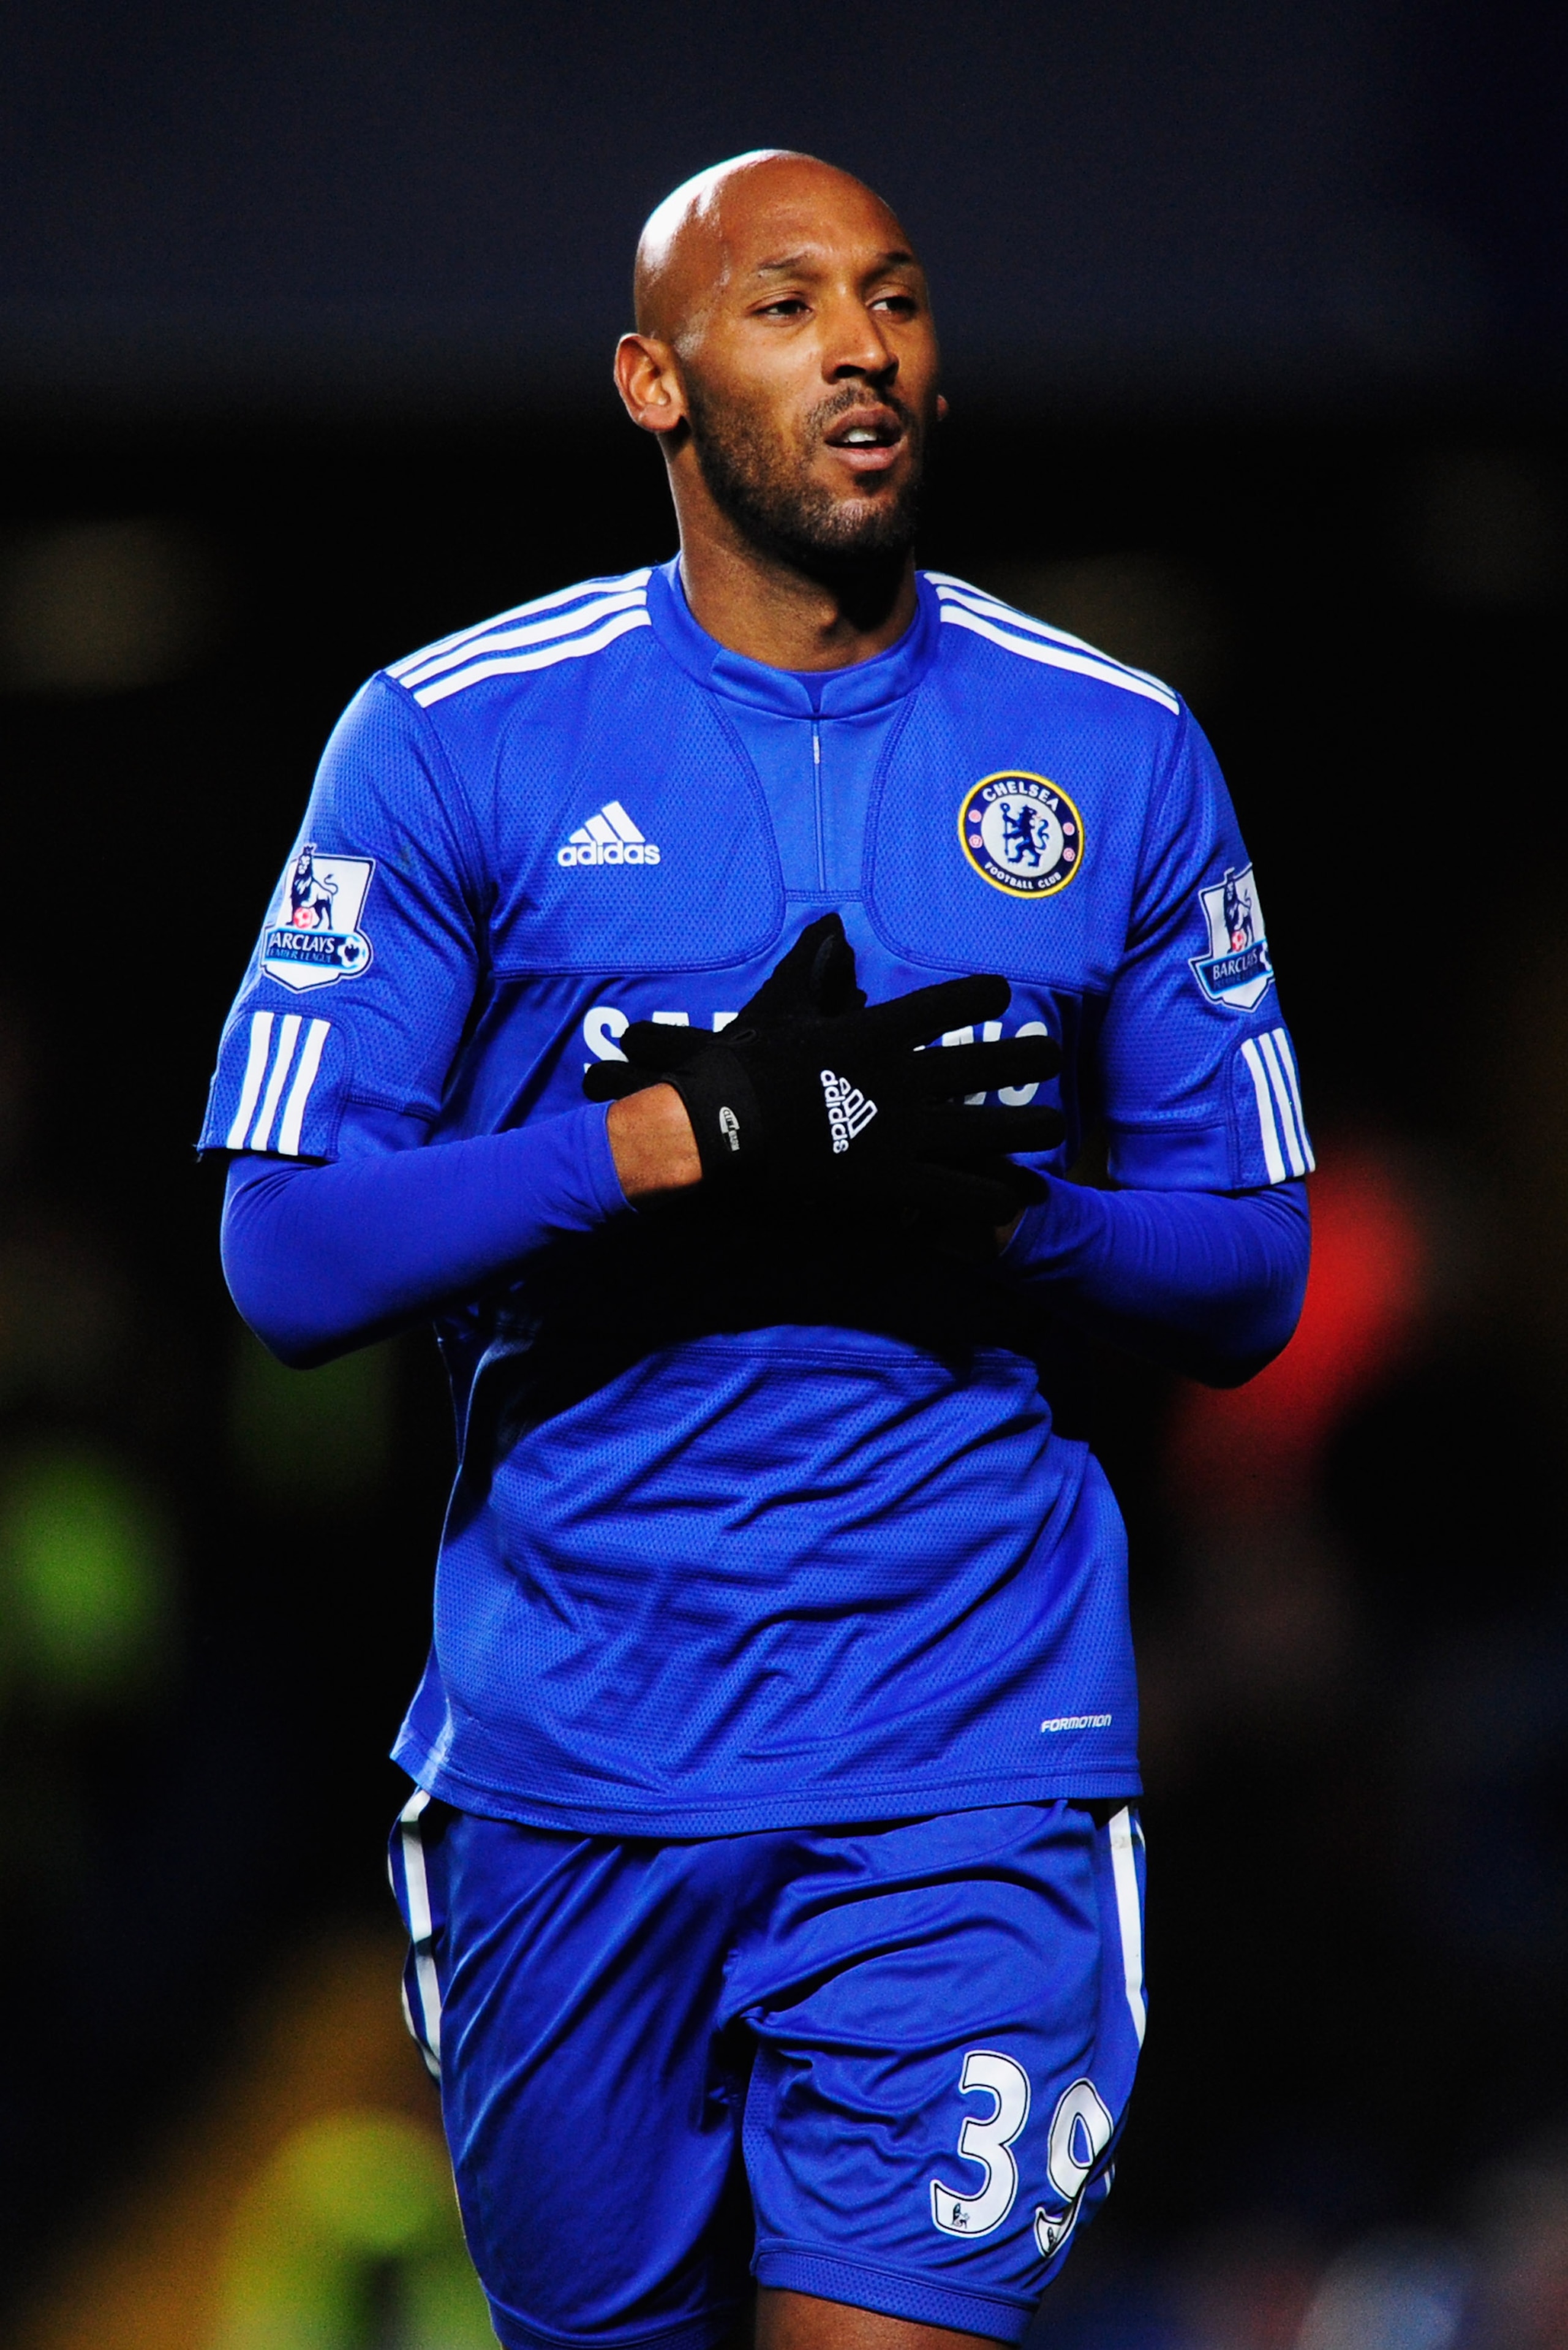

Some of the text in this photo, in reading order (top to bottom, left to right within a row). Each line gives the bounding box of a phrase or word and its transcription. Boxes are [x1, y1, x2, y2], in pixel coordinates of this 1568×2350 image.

[982, 781, 1059, 812] CHELSEA
[557, 840, 661, 867] adidas
[984, 861, 1062, 890] FOOTBALL CLUB
[268, 932, 335, 954] ARCLAYS
[820, 1070, 851, 1154] adidas
[1041, 1714, 1112, 1733] FORMOTION
[930, 2050, 1115, 2257] 39
